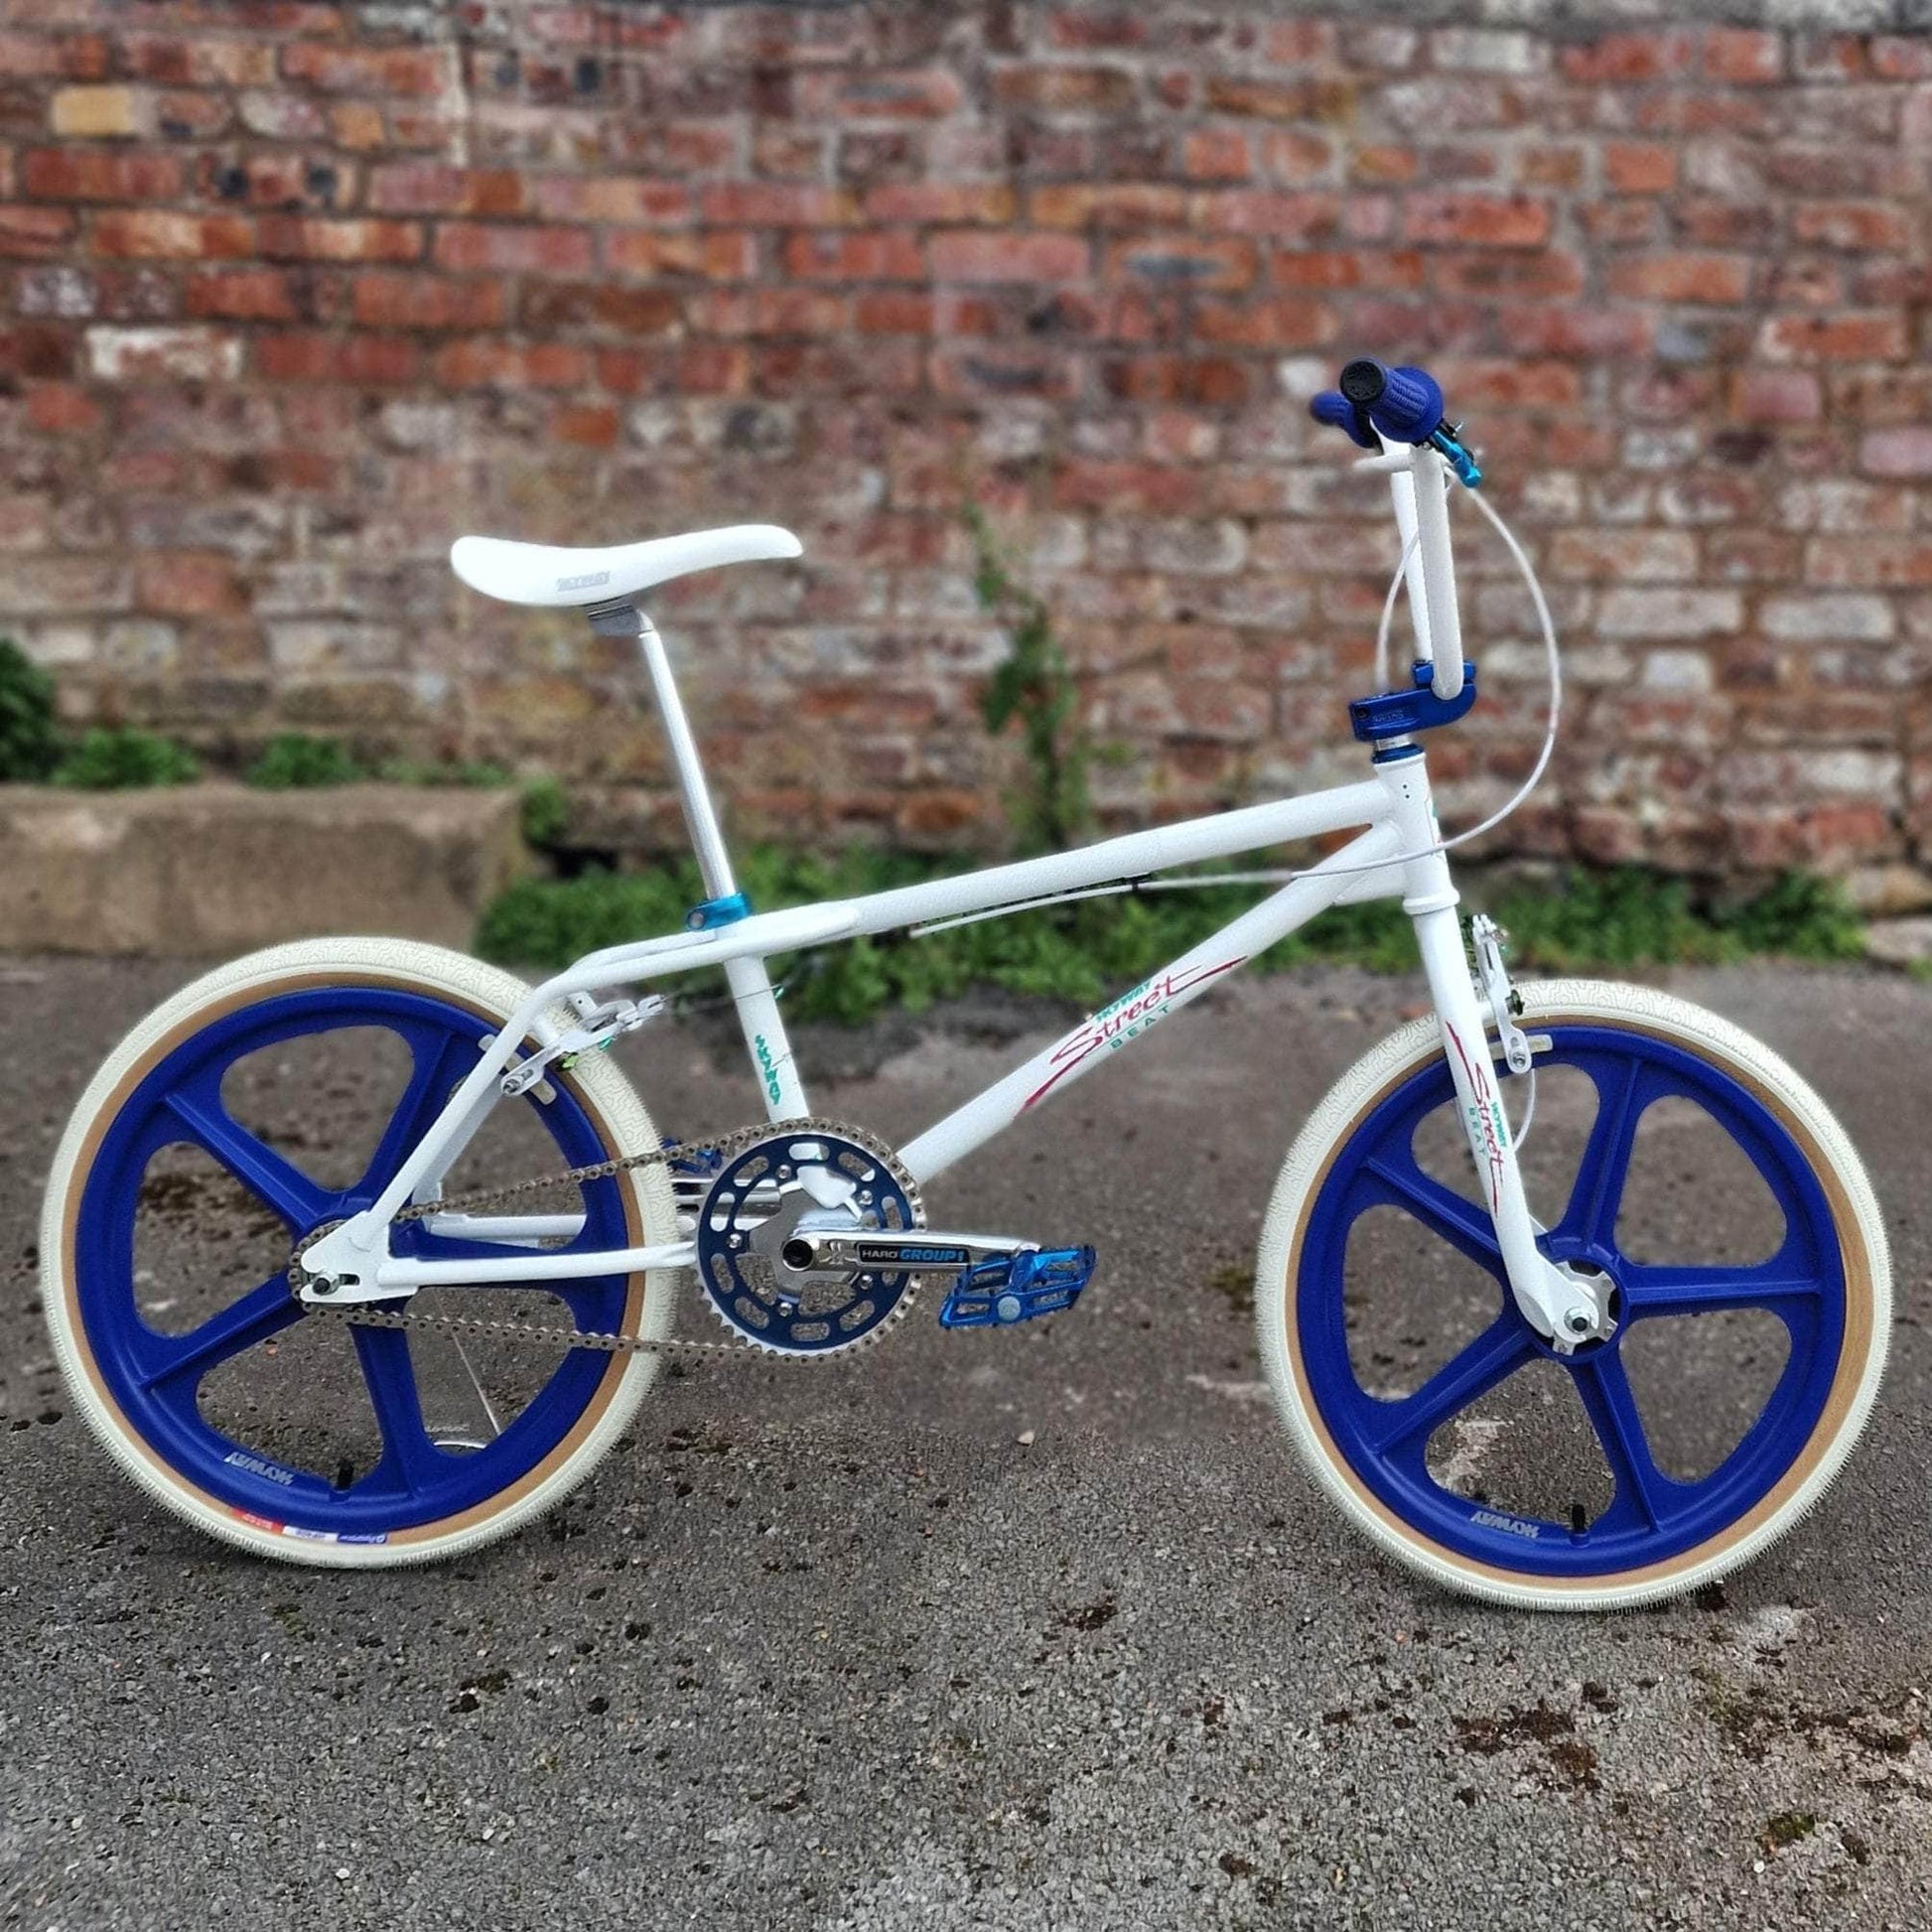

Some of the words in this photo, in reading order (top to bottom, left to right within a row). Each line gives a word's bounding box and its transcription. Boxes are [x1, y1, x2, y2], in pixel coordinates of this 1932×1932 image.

[1094, 980, 1153, 1024] SKYWAY
[1109, 1004, 1172, 1049] BEAT
[1467, 1106, 1487, 1156] BEAT
[1490, 1100, 1508, 1149] SKYWAY
[861, 1248, 898, 1260] HARO
[223, 1451, 295, 1486] SKYWAY
[1470, 1511, 1540, 1539] SKYWAY
